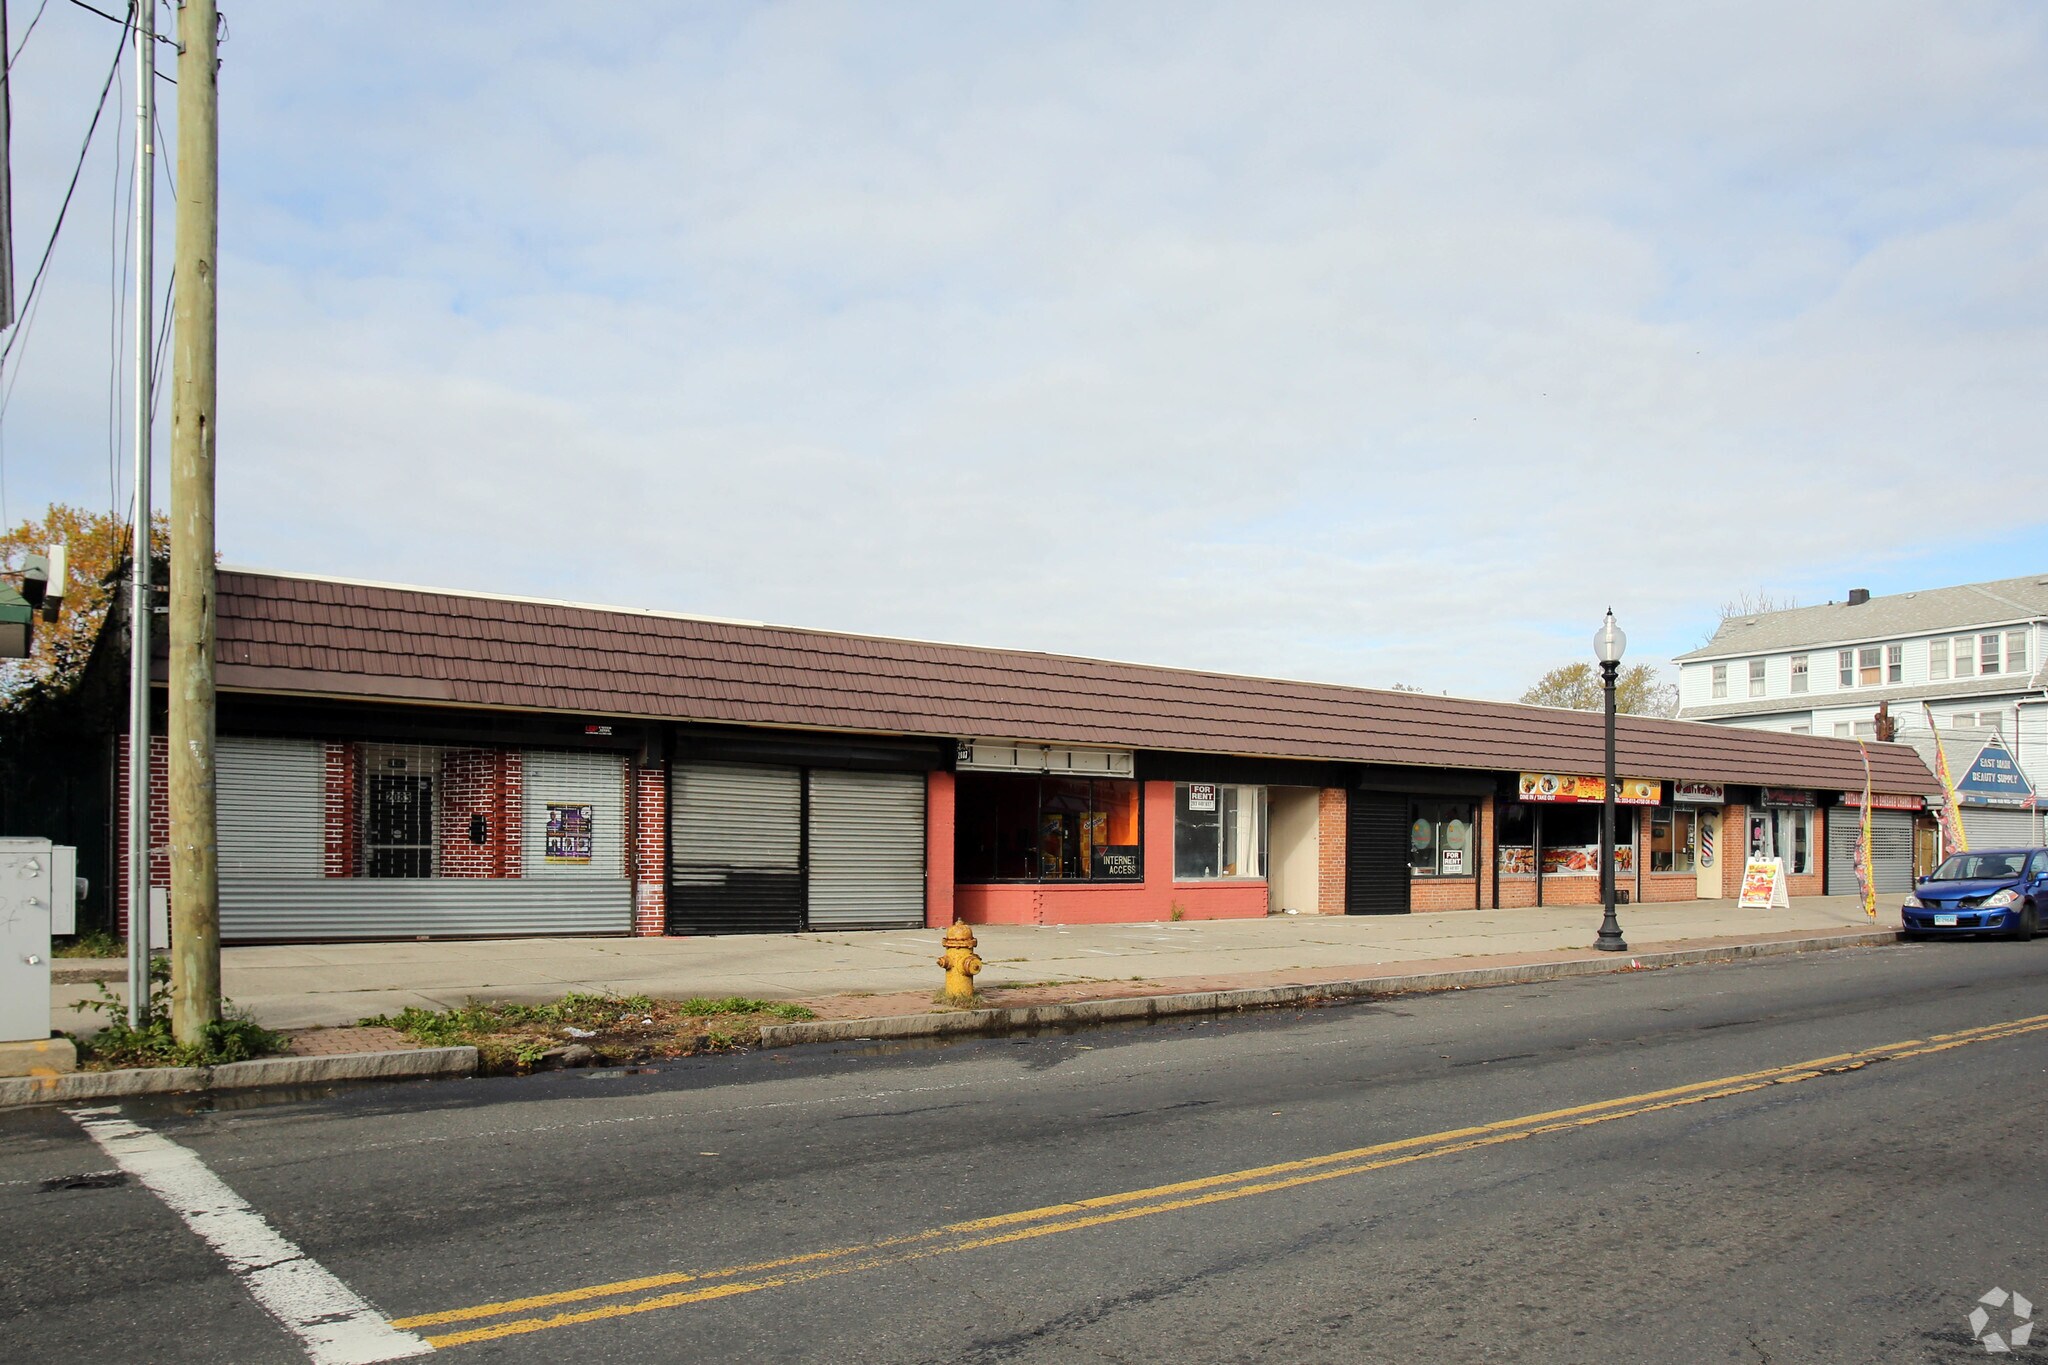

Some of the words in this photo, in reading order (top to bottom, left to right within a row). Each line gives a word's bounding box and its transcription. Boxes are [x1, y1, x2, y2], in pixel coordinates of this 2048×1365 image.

[1980, 758, 1995, 768] EAST
[1997, 759, 2011, 769] MAIN
[1972, 772, 1996, 783] BEAUTY
[1997, 774, 2018, 784] SUPPLY
[1194, 785, 1211, 793] FOR
[1192, 792, 1214, 800] RENT
[1103, 856, 1136, 866] INTERNET
[1109, 866, 1136, 876] ACCESS
